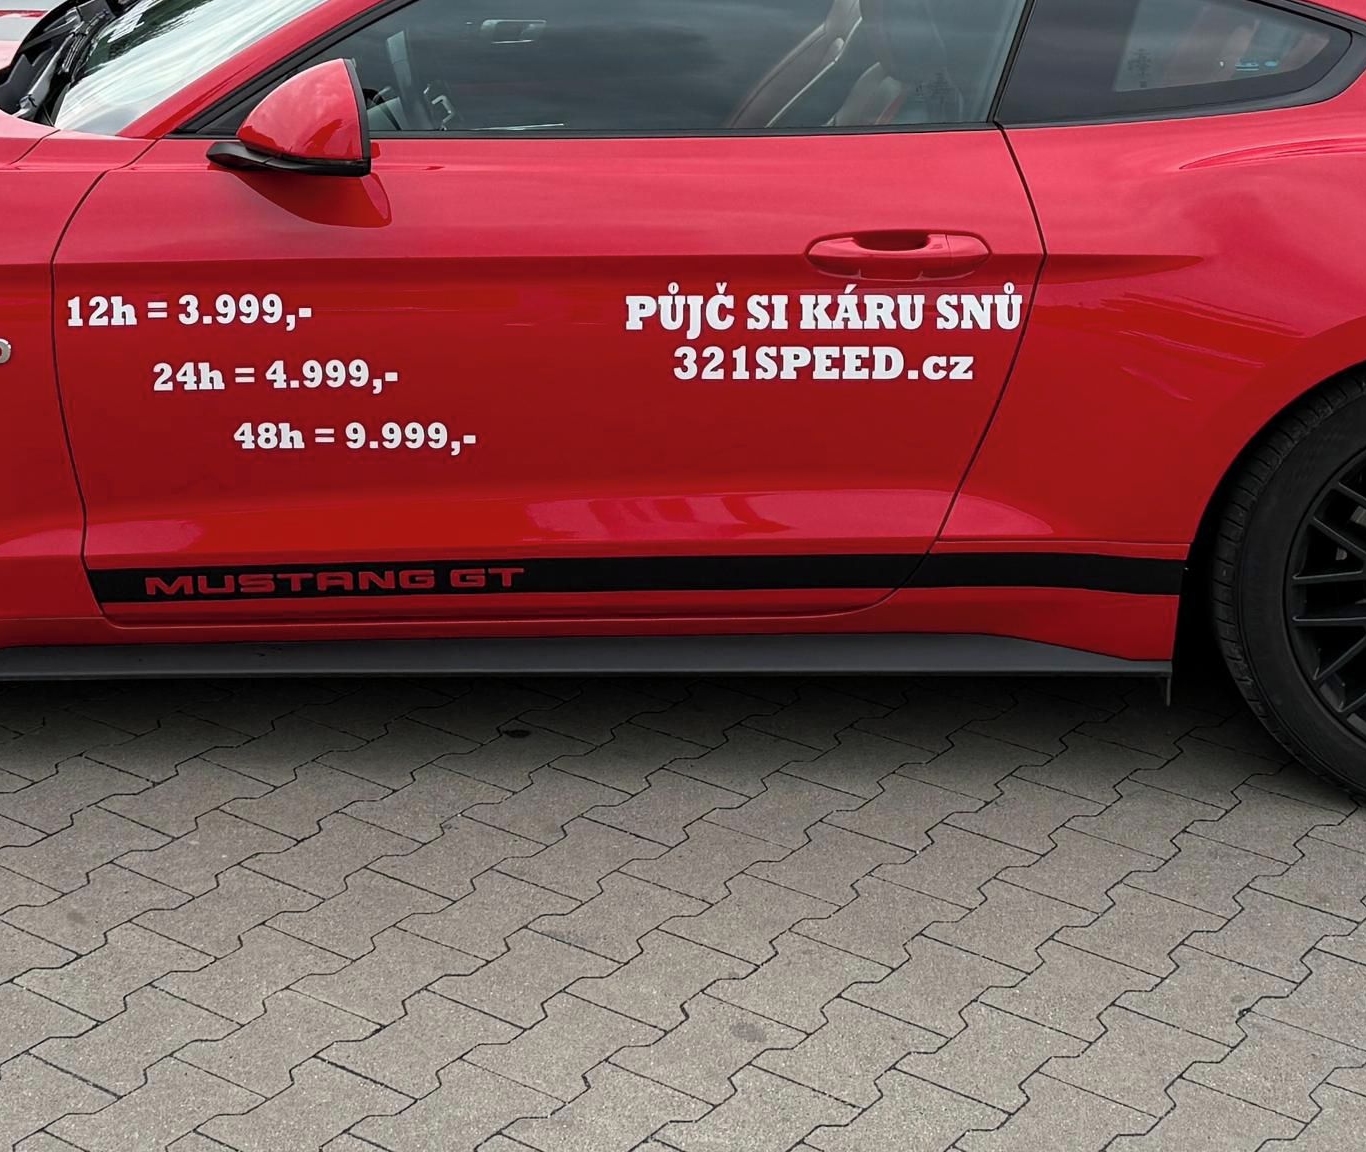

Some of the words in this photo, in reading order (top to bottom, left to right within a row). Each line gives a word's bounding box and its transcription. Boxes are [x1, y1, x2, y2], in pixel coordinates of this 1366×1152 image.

[66, 295, 138, 327] 12h
[146, 300, 168, 320] =
[178, 293, 313, 331] 3.999,-
[625, 281, 736, 340] PŮJČ
[747, 293, 789, 330] SI
[799, 284, 926, 330] KÁRU
[936, 281, 1023, 330] SNŮ
[152, 362, 226, 392] 24h
[234, 366, 256, 385] =
[265, 359, 399, 395] 4.999,-
[673, 345, 975, 381] 321SPEED.cz
[233, 423, 305, 450] 48h
[314, 427, 336, 445] =
[345, 422, 477, 457] 9.999,-
[145, 569, 436, 597] MUSTANG
[450, 567, 525, 588] GT
